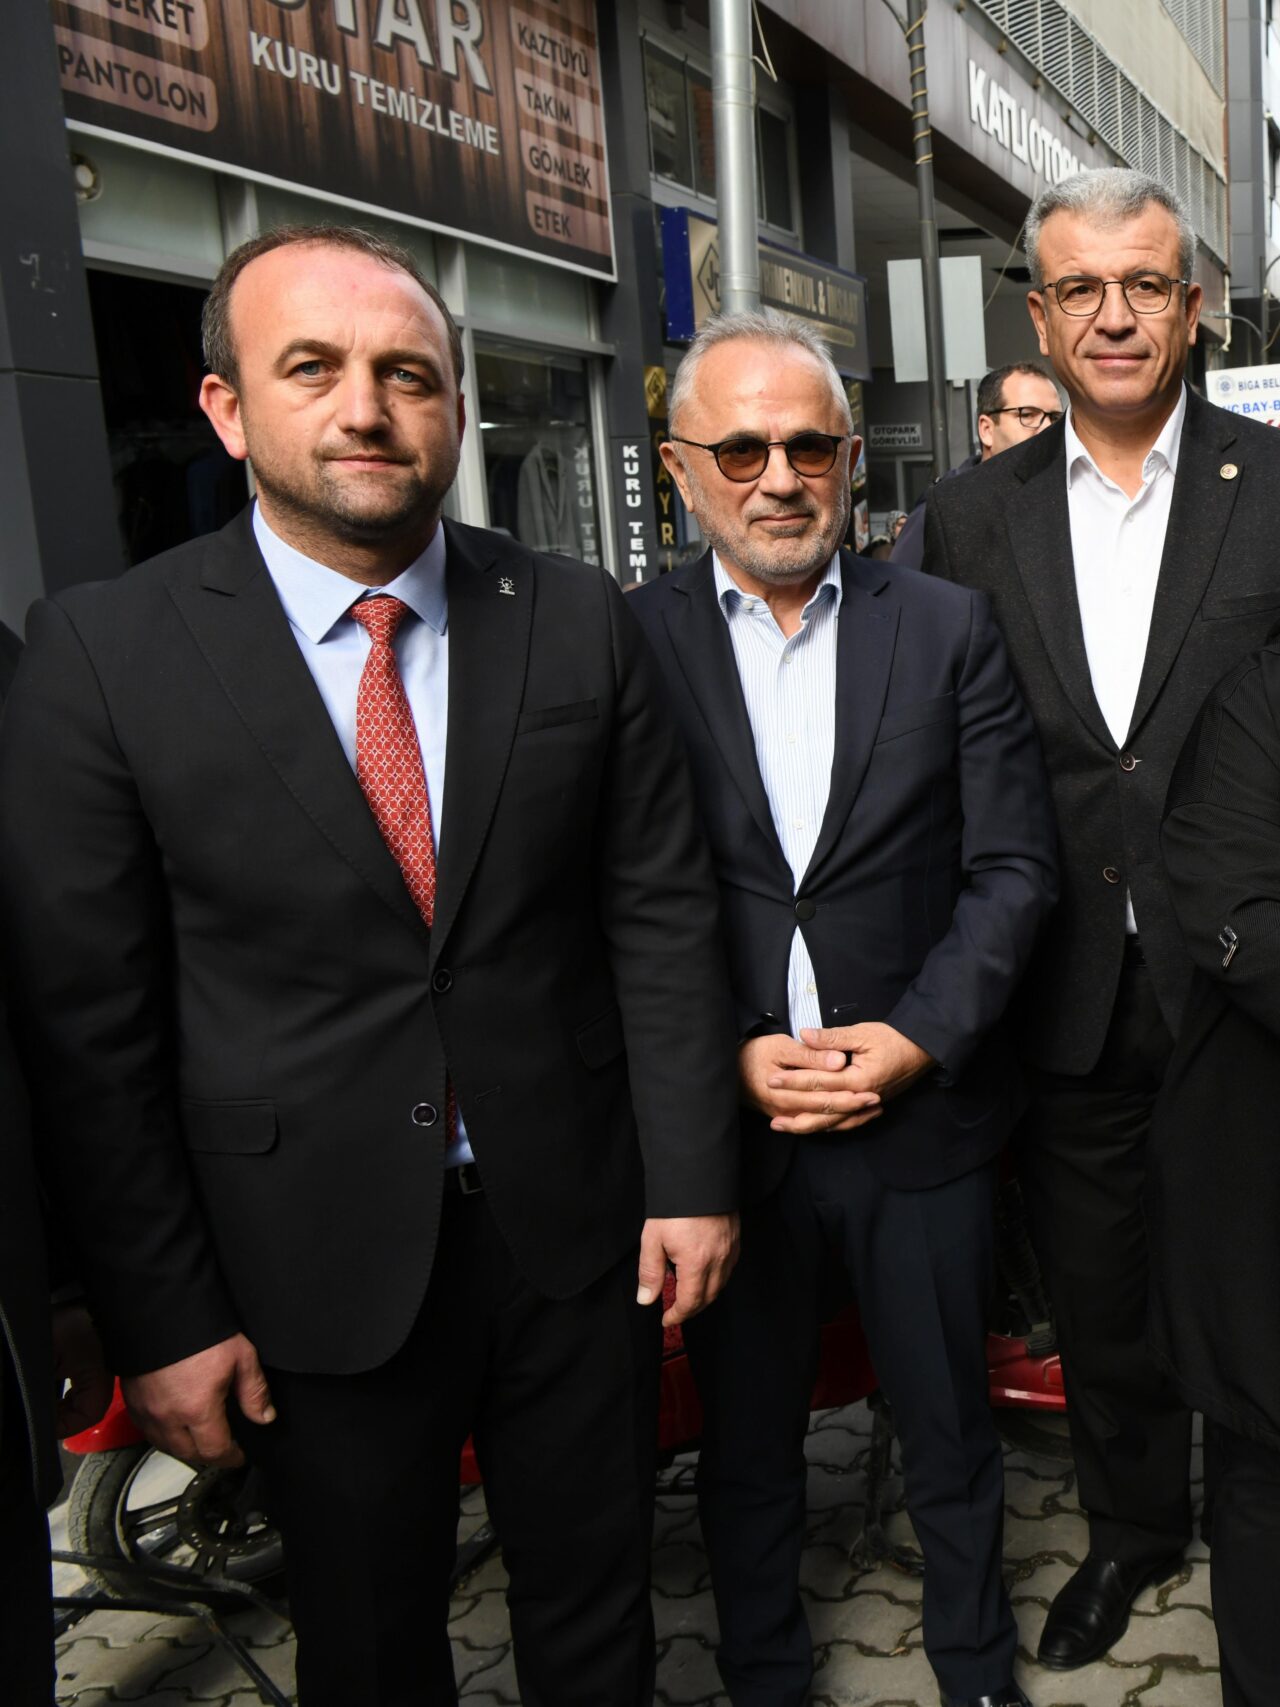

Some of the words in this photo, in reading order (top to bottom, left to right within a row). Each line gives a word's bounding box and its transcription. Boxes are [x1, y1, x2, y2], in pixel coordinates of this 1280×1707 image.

[518, 23, 588, 77] KAZTÜYÜ
[58, 44, 207, 119] PANTOLON
[250, 30, 342, 95] KURU
[349, 70, 499, 155] TEMİZLEME
[523, 85, 572, 126] TAKIM
[968, 59, 1028, 164] KATLI
[529, 144, 591, 190] GÖMLEK
[533, 205, 571, 238] ETEK
[873, 426, 917, 435] OTOPARK
[623, 446, 642, 507] KURU
